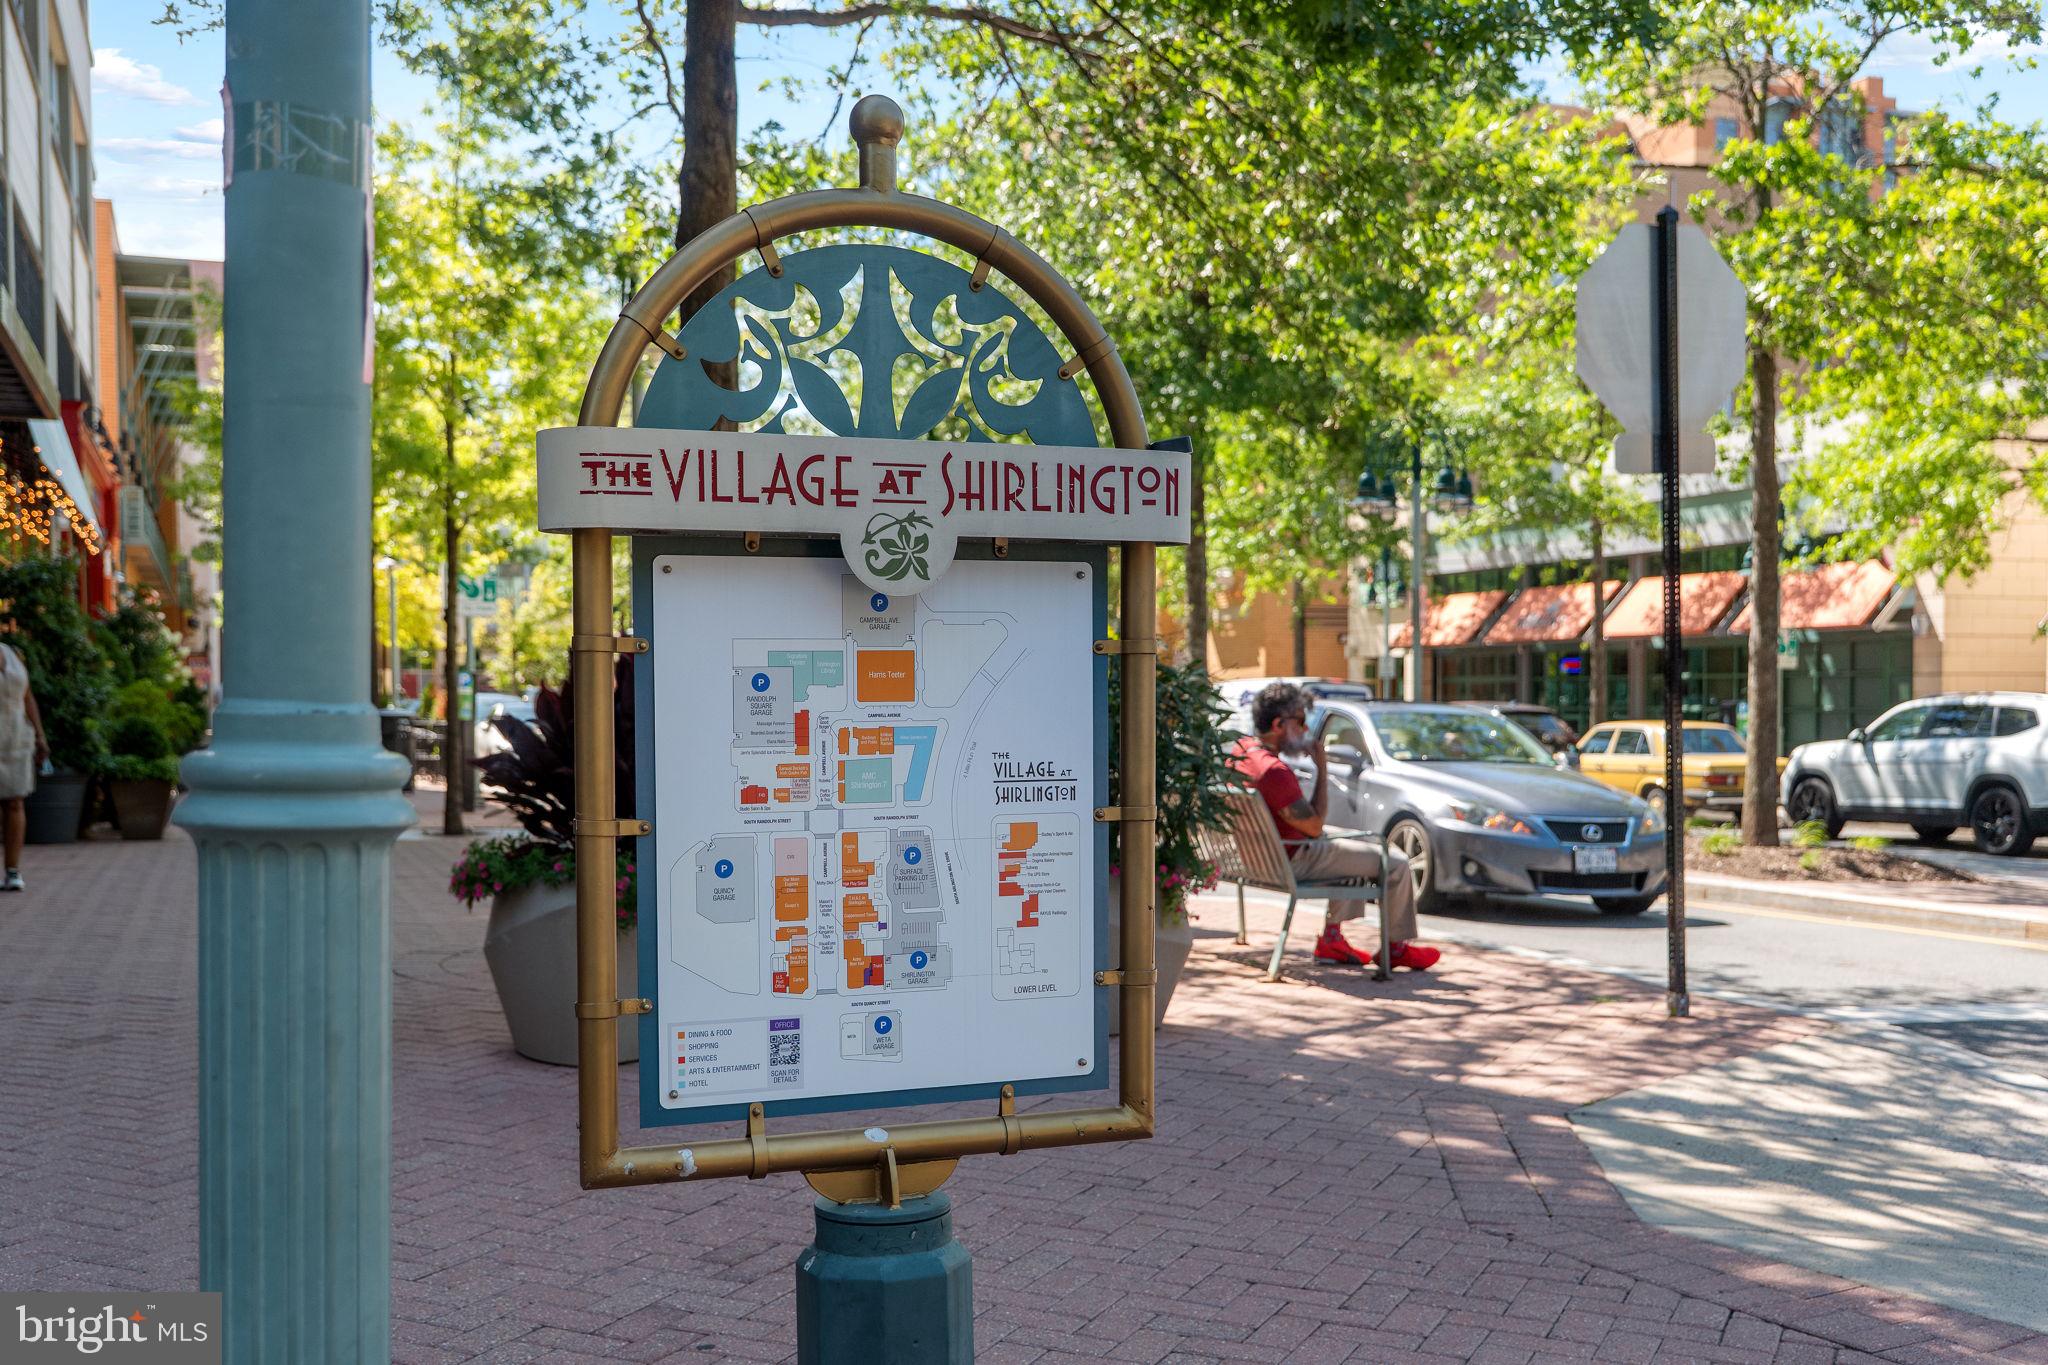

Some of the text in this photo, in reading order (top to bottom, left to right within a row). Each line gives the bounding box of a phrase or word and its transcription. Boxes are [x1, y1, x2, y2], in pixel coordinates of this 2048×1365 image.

[582, 449, 1179, 517] THE VILLAGE AT SHIRLINGTON
[994, 761, 1055, 778] VILLAGE
[995, 785, 1076, 805] SHIRLINGTON
[901, 971, 936, 979] SHIRLINGTON
[1013, 984, 1057, 994] LOWER LEVEL
[688, 1042, 719, 1051] SHOPPING
[873, 1042, 894, 1050] GARAGE
[688, 1054, 718, 1063] SERVICES
[689, 1067, 705, 1075] ARTS
[712, 1063, 760, 1073] ENTERTAINMENT
[770, 1069, 787, 1077] SCAN
